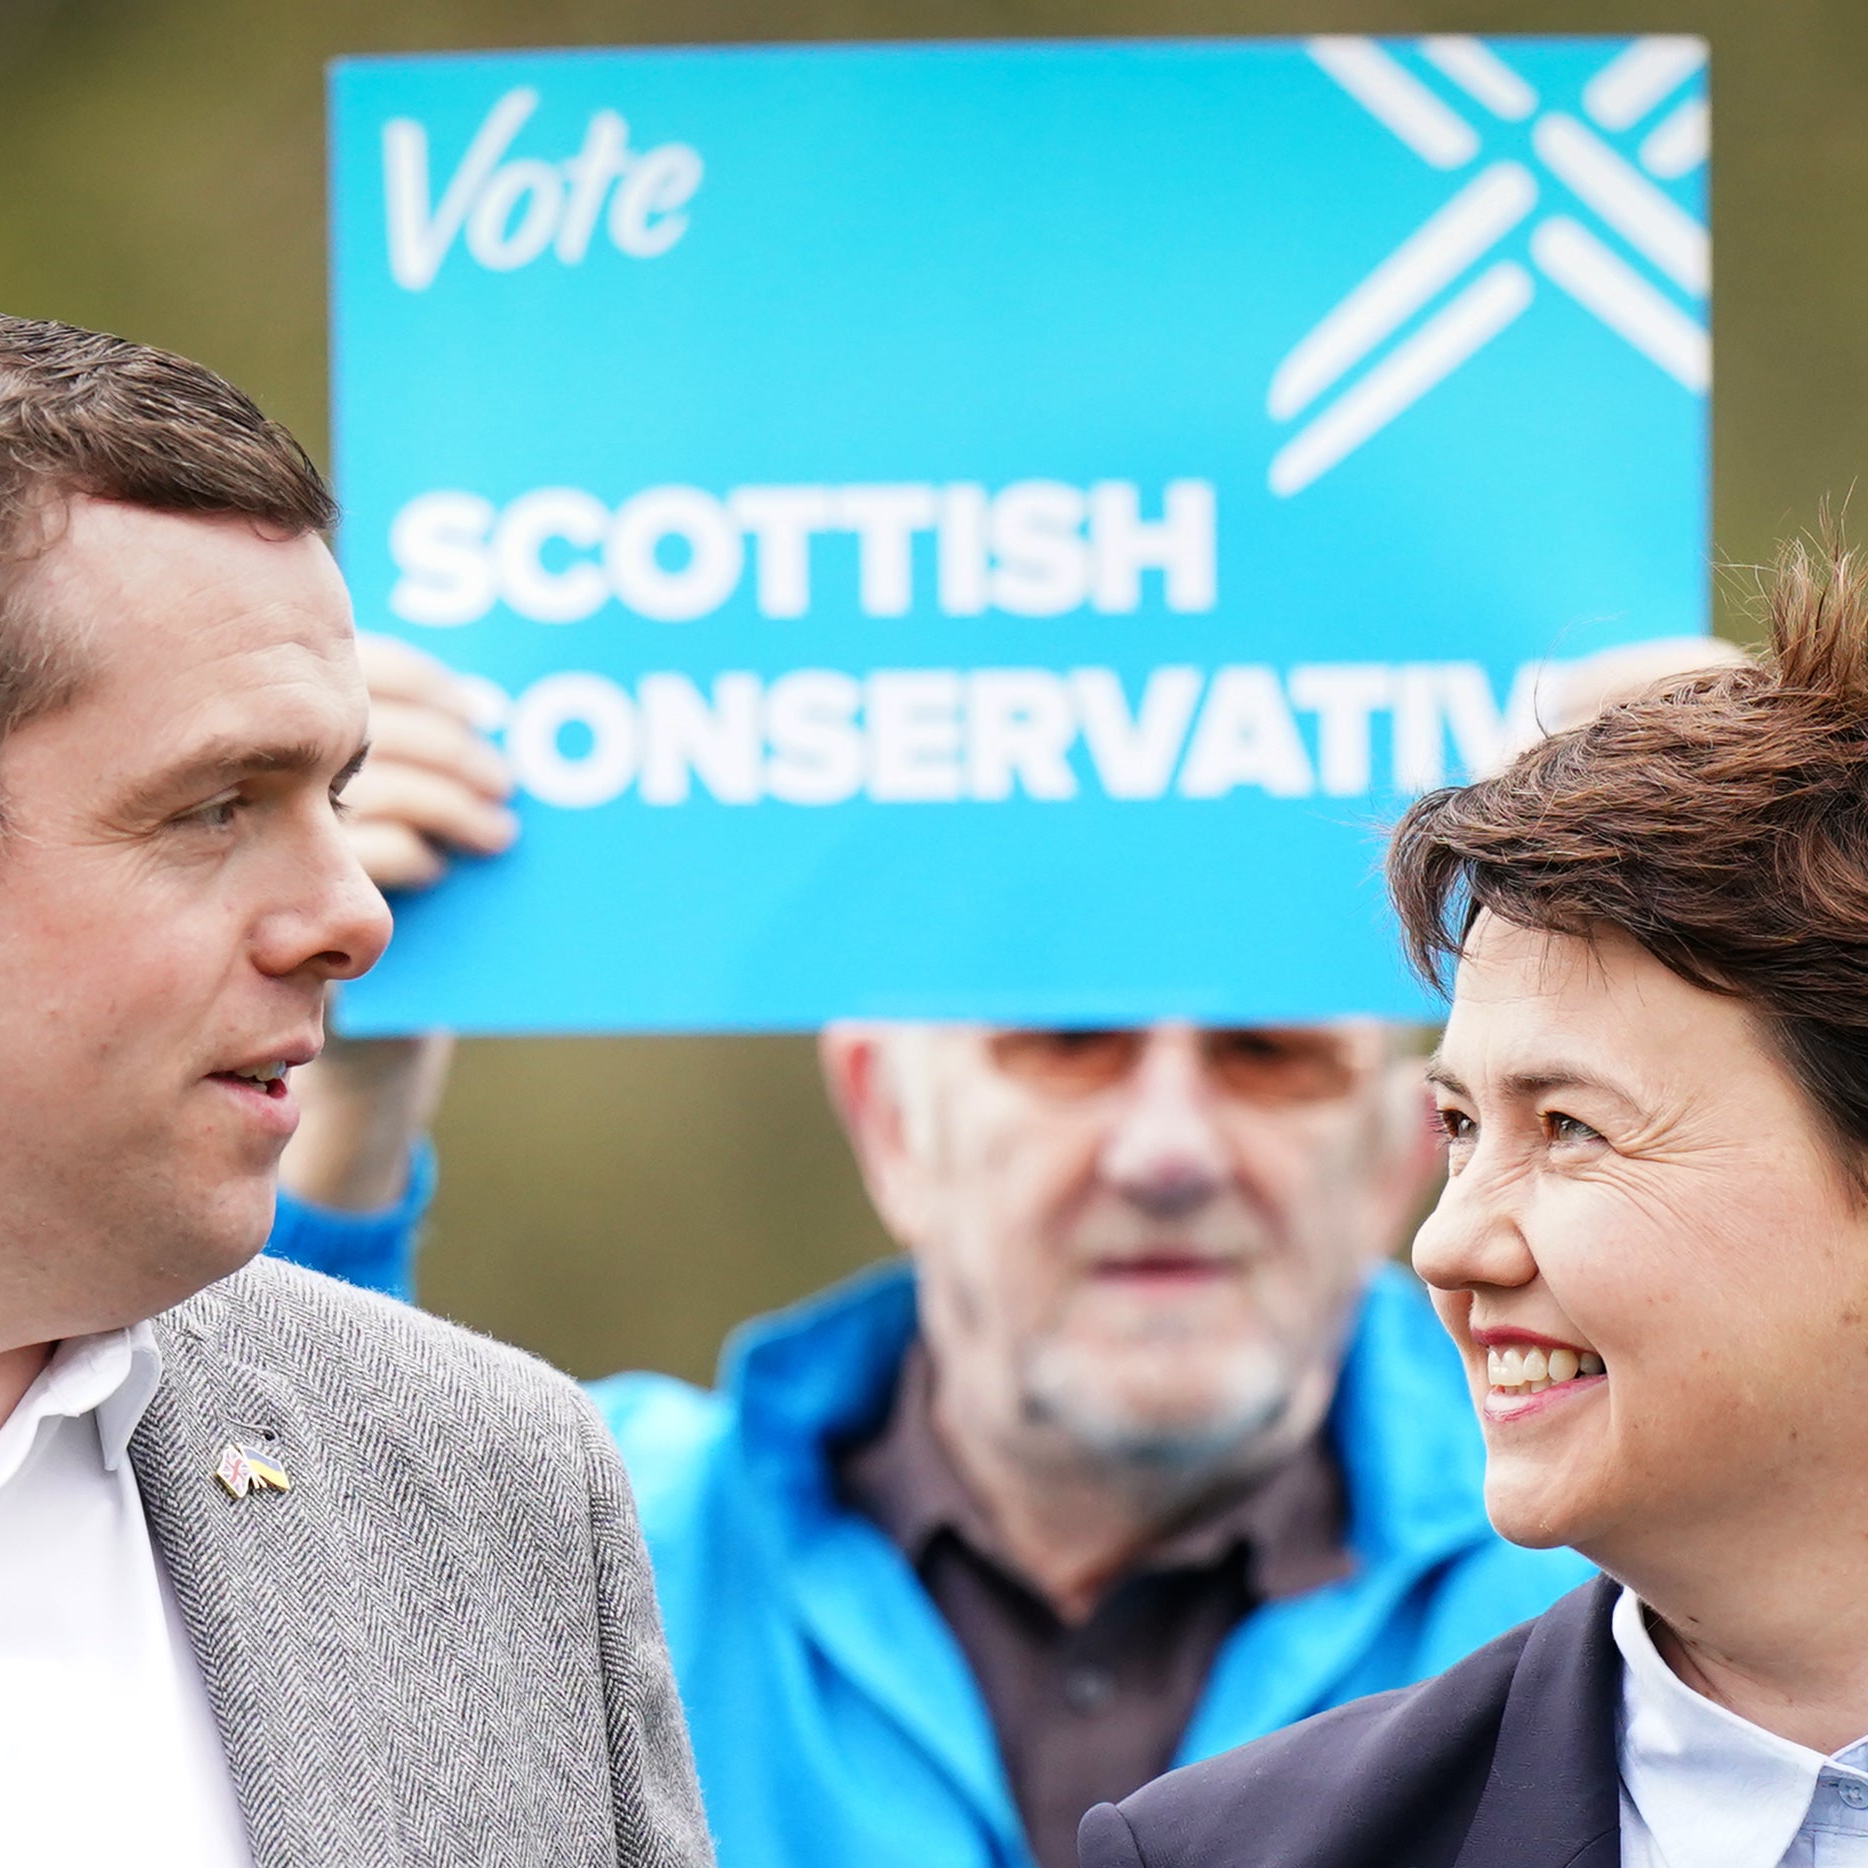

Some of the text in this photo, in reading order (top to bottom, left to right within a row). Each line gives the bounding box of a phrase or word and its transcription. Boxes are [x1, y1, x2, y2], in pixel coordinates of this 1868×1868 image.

[382, 87, 704, 293] Vote
[388, 479, 1218, 629] SCOTTISH
[457, 660, 1564, 818] ONSERVATIV
